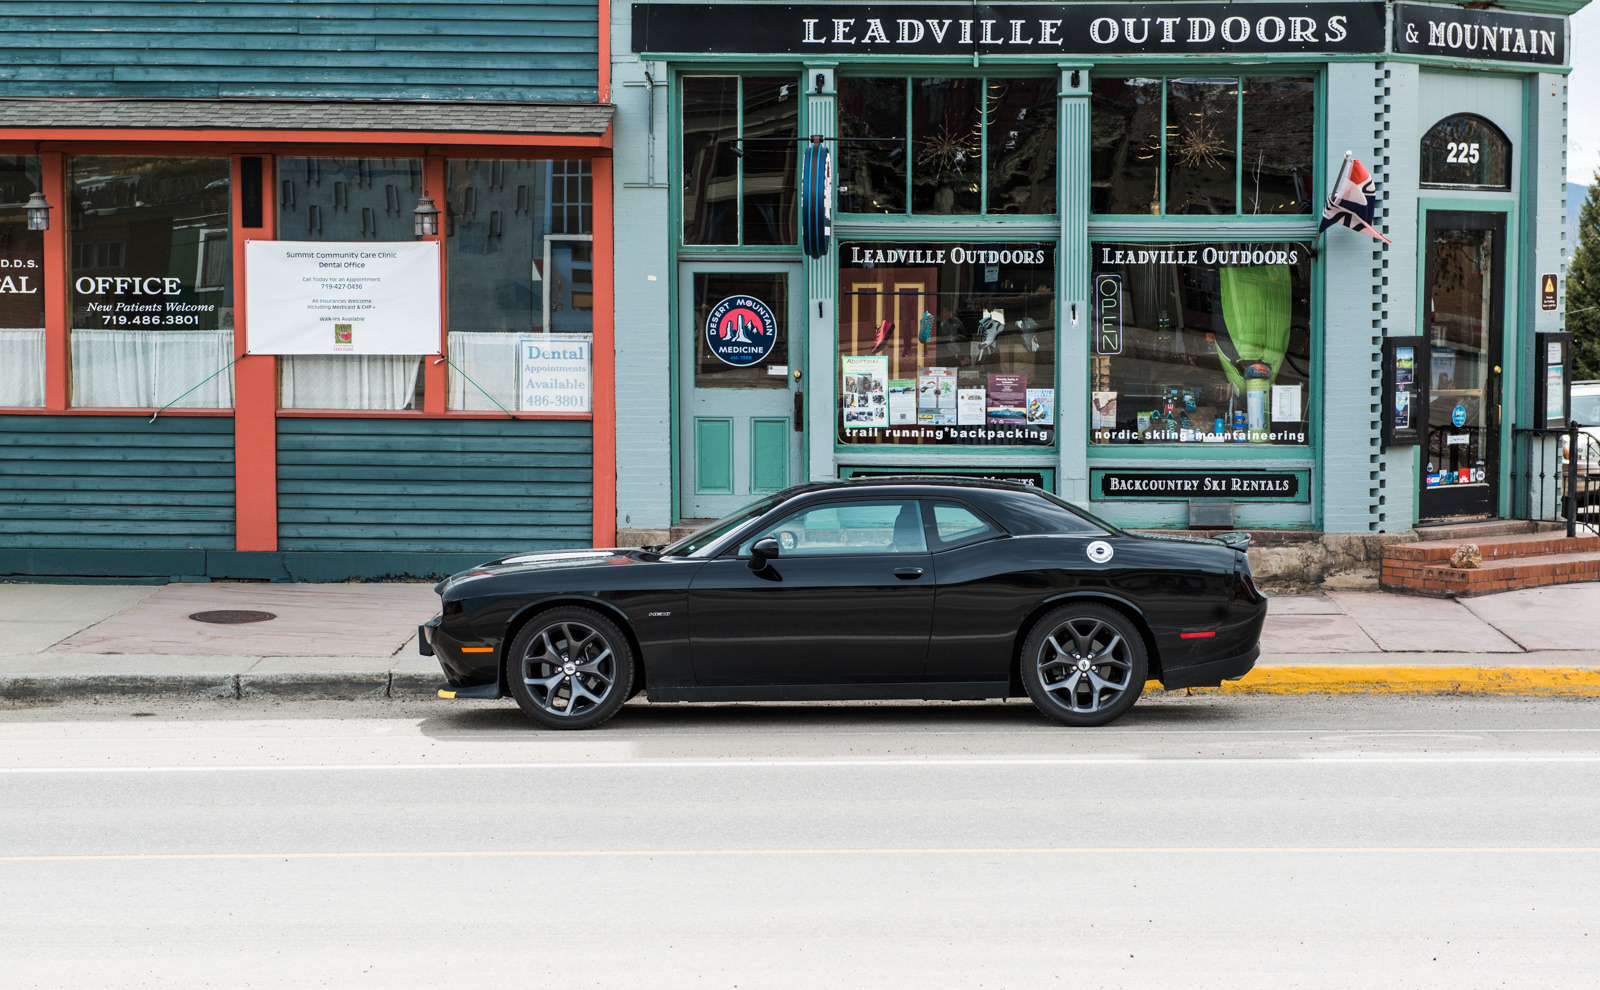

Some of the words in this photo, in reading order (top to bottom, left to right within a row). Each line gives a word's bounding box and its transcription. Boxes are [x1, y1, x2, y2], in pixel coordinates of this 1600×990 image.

[802, 19, 1063, 45] LEADVILLE
[1090, 16, 1346, 43] OUTDOORS
[1406, 23, 1418, 43] &
[1428, 20, 1556, 57] MOUNTAIN
[1447, 142, 1479, 163] 225
[286, 251, 315, 259] Summit
[852, 247, 946, 266] LEADVILLE
[951, 247, 1044, 264] OUTDOORS
[1102, 247, 1197, 264] LEADVILLE
[1203, 247, 1297, 264] OUTDOORS
[0, 259, 39, 268] D.D.S.
[318, 261, 343, 269] Dental
[343, 261, 366, 269] Office
[0, 276, 37, 293] AL
[76, 277, 181, 294] OFFICE
[86, 302, 113, 312] New
[114, 302, 163, 312] Patients
[165, 302, 215, 312] Welcome
[101, 315, 199, 325] 719.486.3801
[709, 302, 730, 336] DESERT
[735, 298, 773, 336] MOUNTAIN
[1099, 278, 1119, 352] OPEN
[527, 345, 585, 360] Dental
[718, 346, 764, 354] MEDICINE
[524, 363, 587, 374] Appointments
[525, 377, 586, 390] Available
[526, 394, 585, 407] 486-3801
[843, 426, 878, 438] trail
[1094, 429, 1140, 441] nordic
[1109, 477, 1200, 491] BACKCOUNTRY
[1203, 477, 1227, 491] SKI
[1230, 477, 1289, 491] RENTALS
